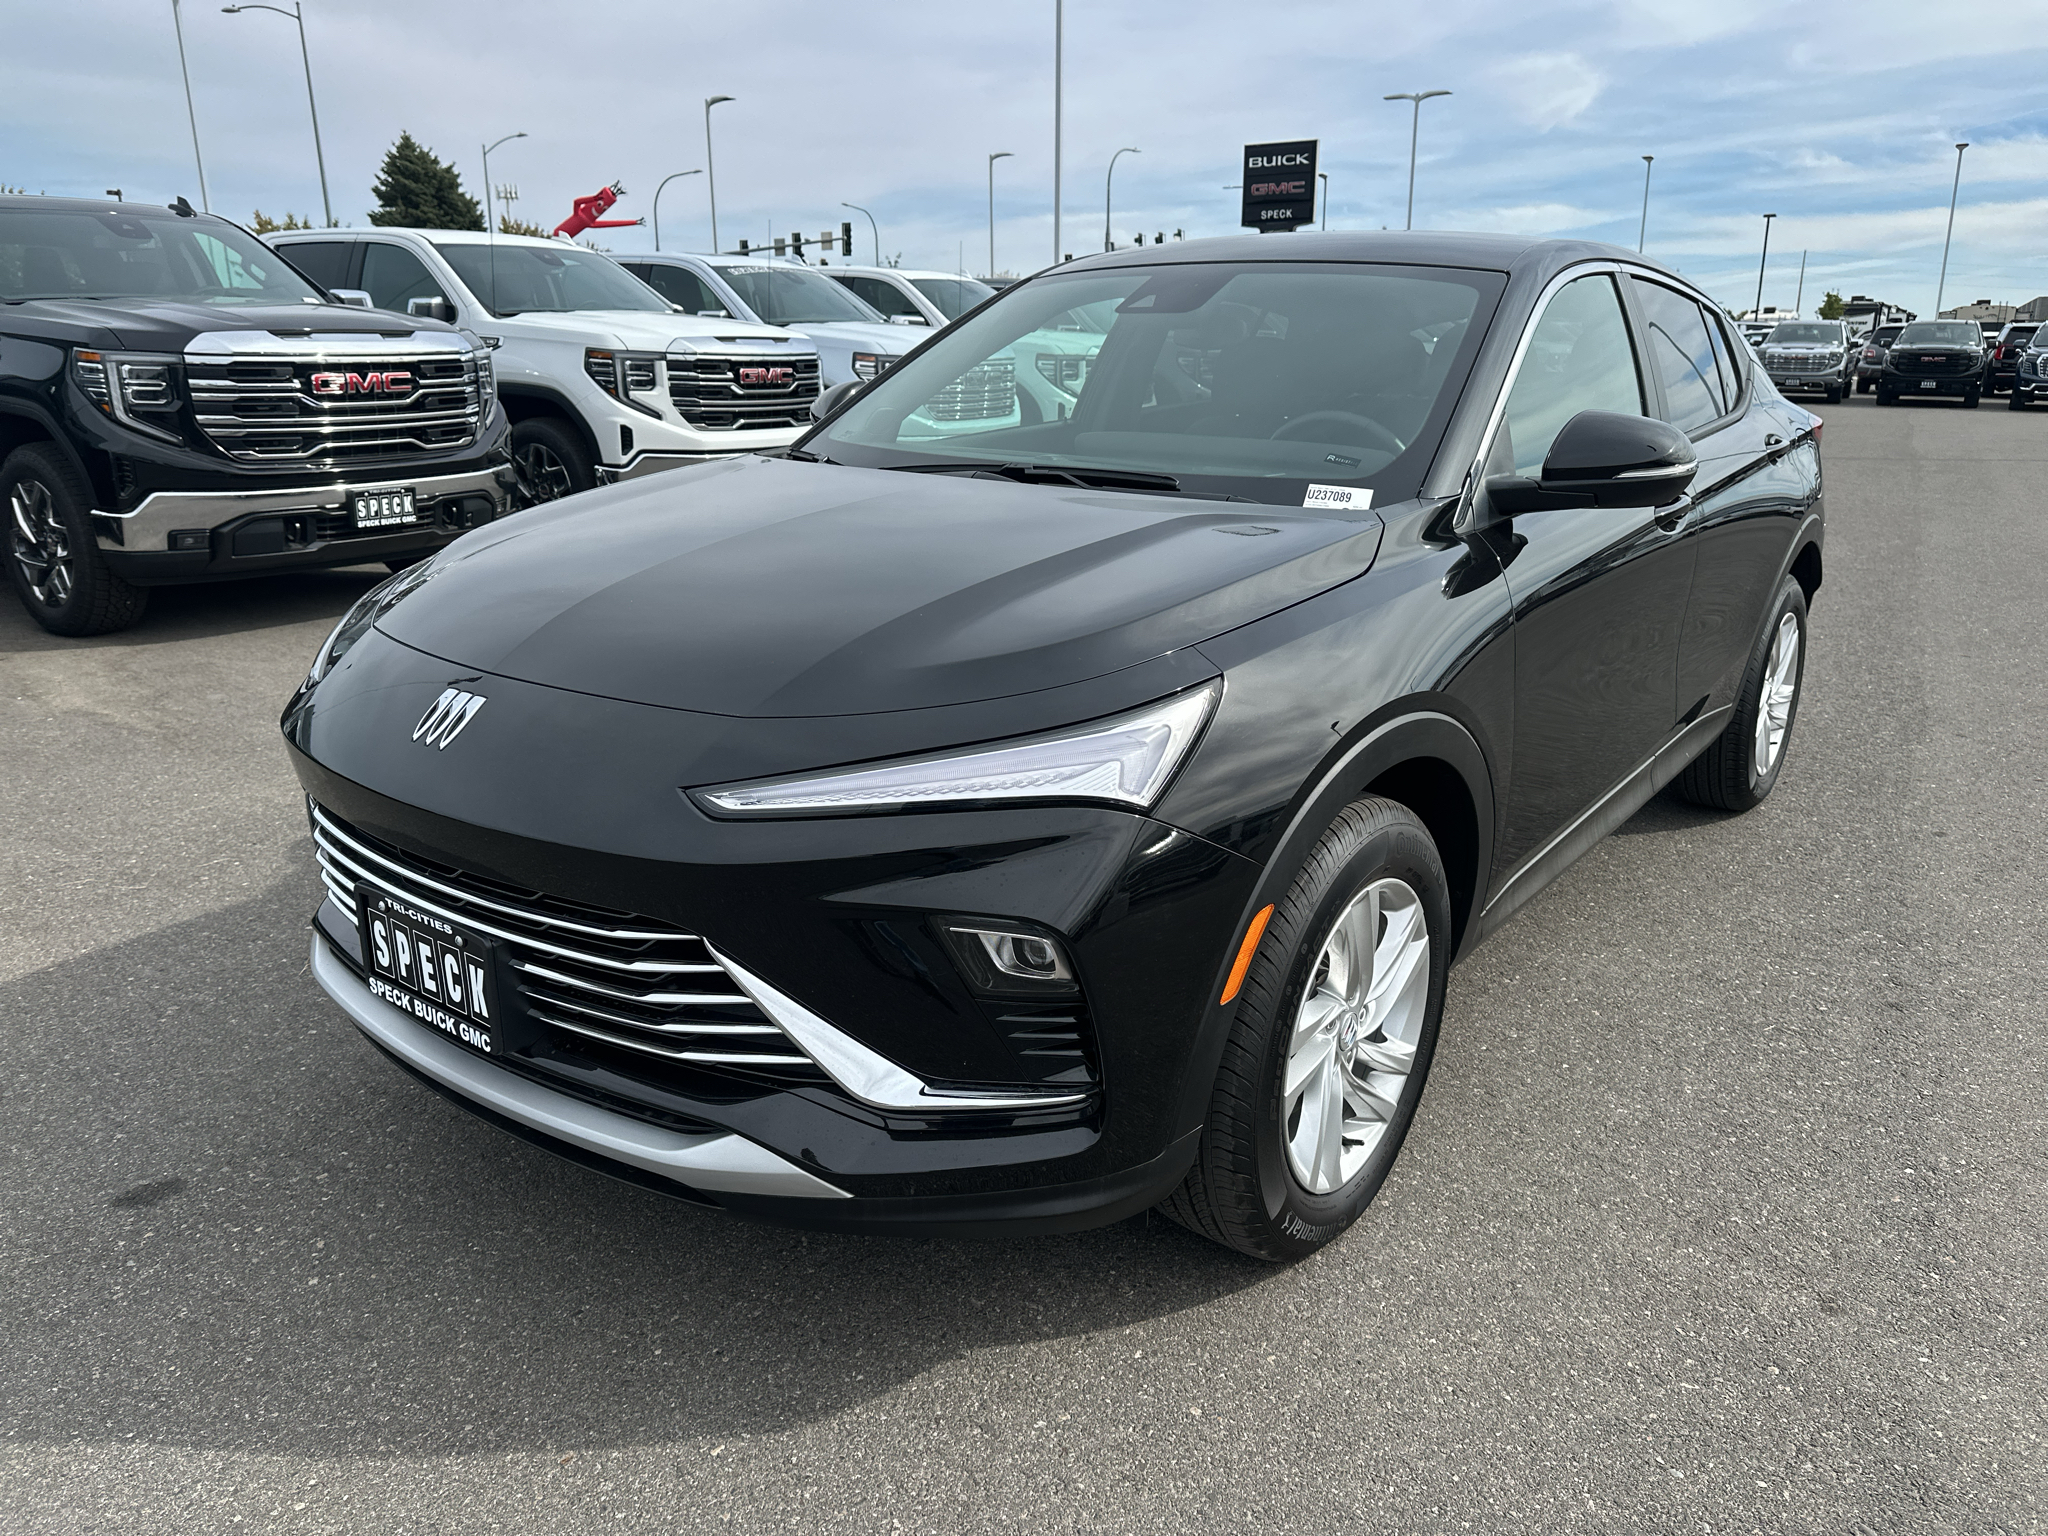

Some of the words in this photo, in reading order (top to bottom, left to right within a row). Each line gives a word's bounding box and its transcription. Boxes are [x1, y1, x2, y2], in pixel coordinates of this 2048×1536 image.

[1248, 153, 1309, 168] BUICK
[1251, 181, 1305, 196] GMC
[1260, 208, 1293, 220] SPECK
[310, 371, 412, 395] GMC
[739, 367, 794, 384] GMC
[356, 495, 413, 518] SPECK
[1307, 488, 1352, 503] U237089
[357, 519, 380, 528] SPECK
[380, 516, 402, 526] BUICK
[401, 514, 417, 523] GMC
[1396, 831, 1440, 878] Continental
[384, 897, 453, 935] TRI-CITIES
[372, 918, 490, 1019] SPECK
[368, 977, 413, 1013] SPECK
[414, 998, 458, 1036] BUICK
[459, 1023, 492, 1054] GMC
[1284, 1212, 1349, 1247] Continental
